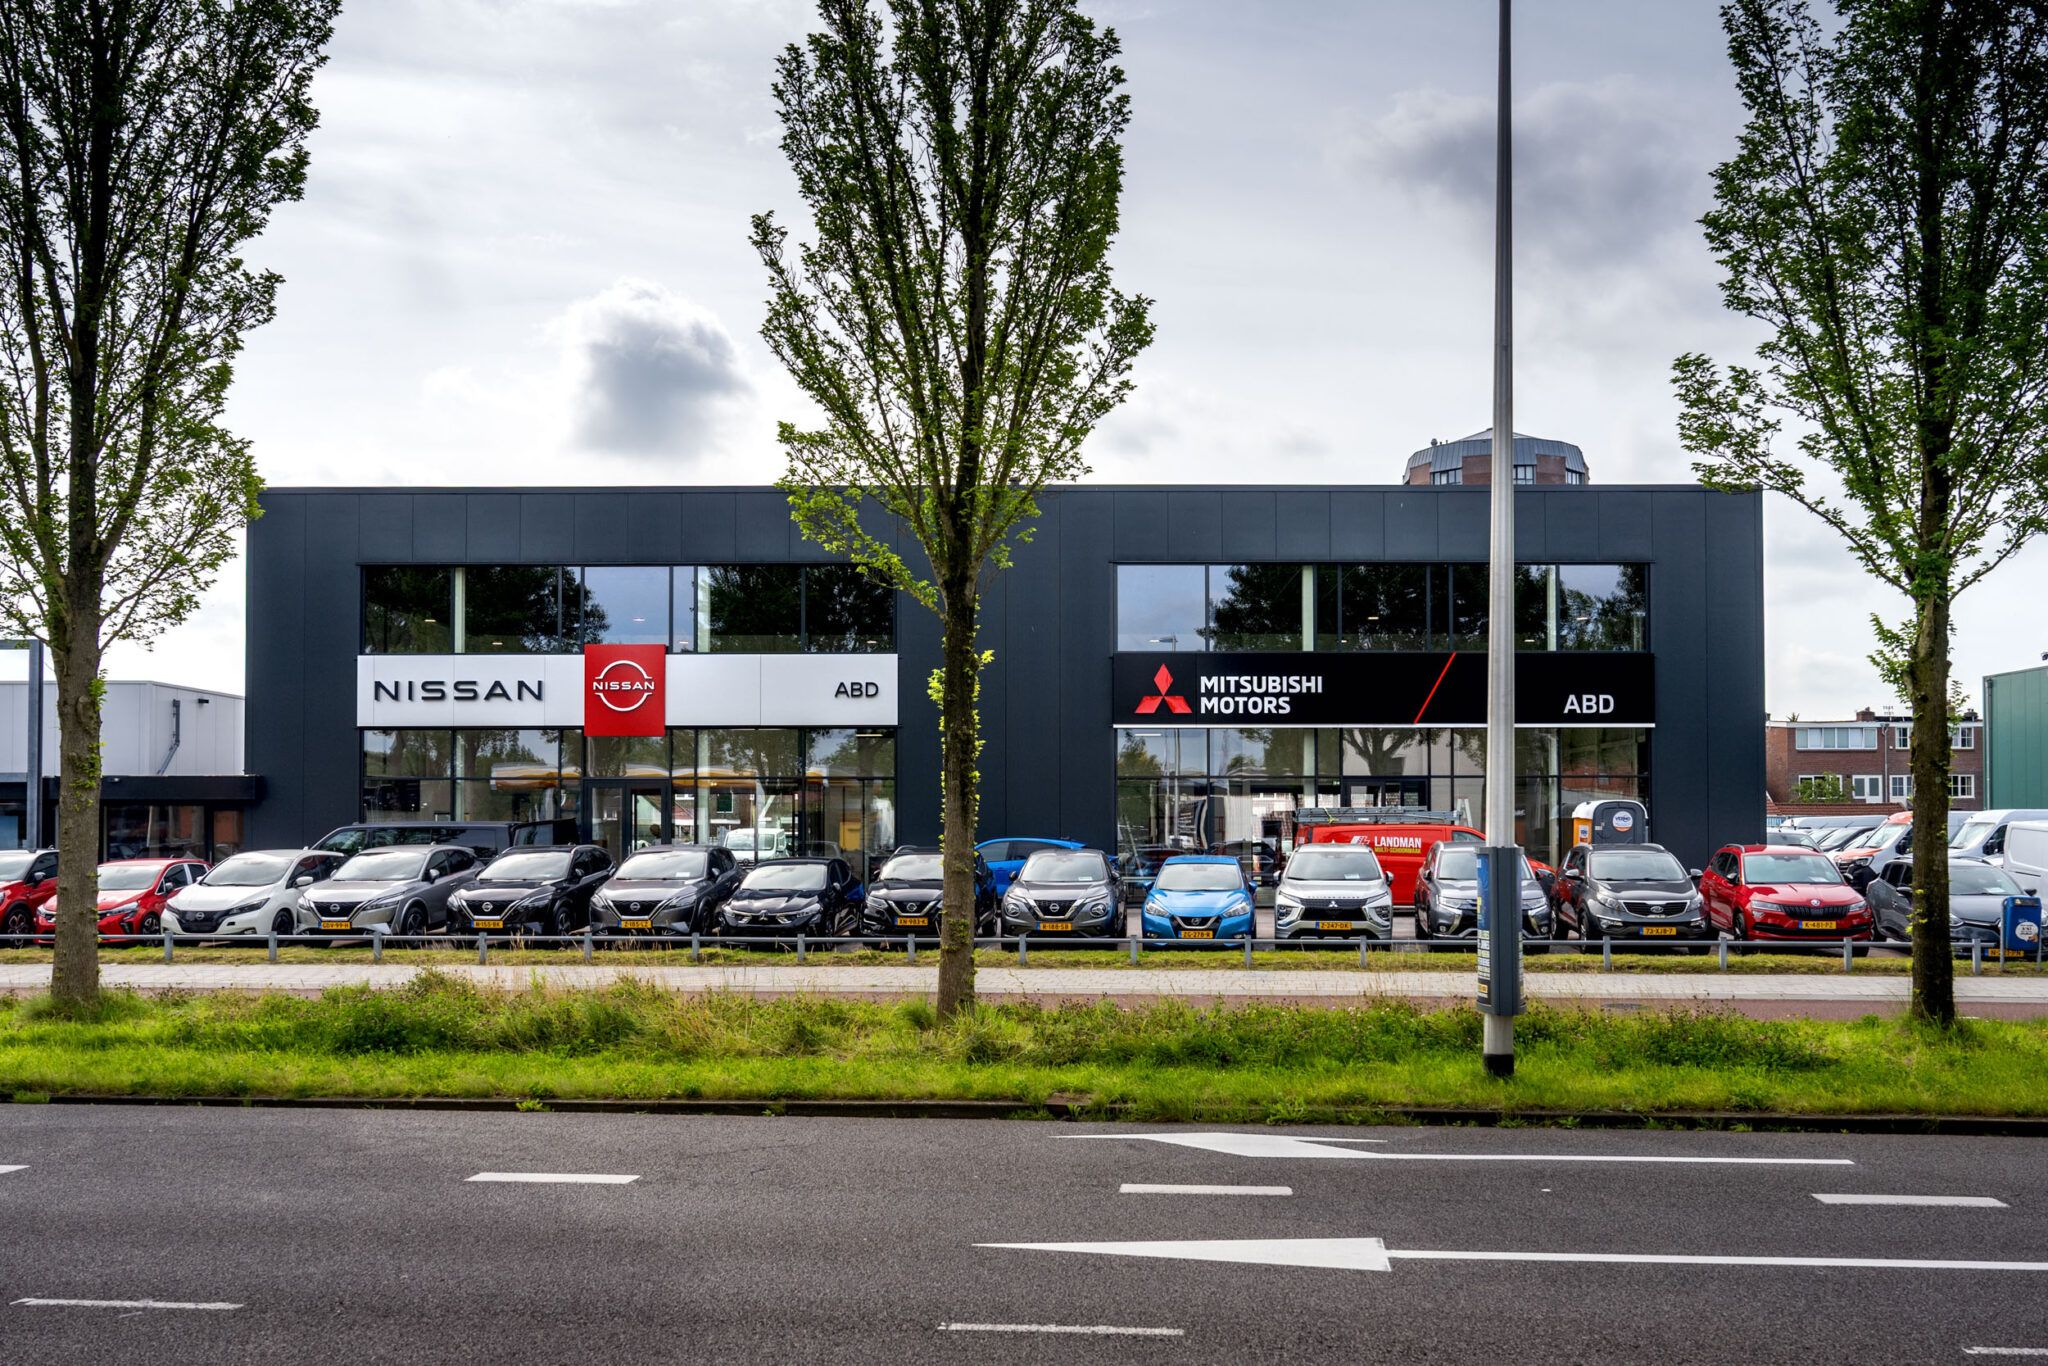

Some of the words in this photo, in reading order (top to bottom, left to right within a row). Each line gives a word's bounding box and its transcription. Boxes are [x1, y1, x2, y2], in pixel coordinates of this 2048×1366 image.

[374, 680, 543, 701] NISSAN
[593, 681, 654, 690] NISSAN
[834, 681, 879, 698] ABD
[1200, 676, 1323, 693] MITSUBISHI
[1200, 696, 1291, 714] MOTORS
[1563, 694, 1615, 714] ABD
[1374, 836, 1422, 848] LANDMAN
